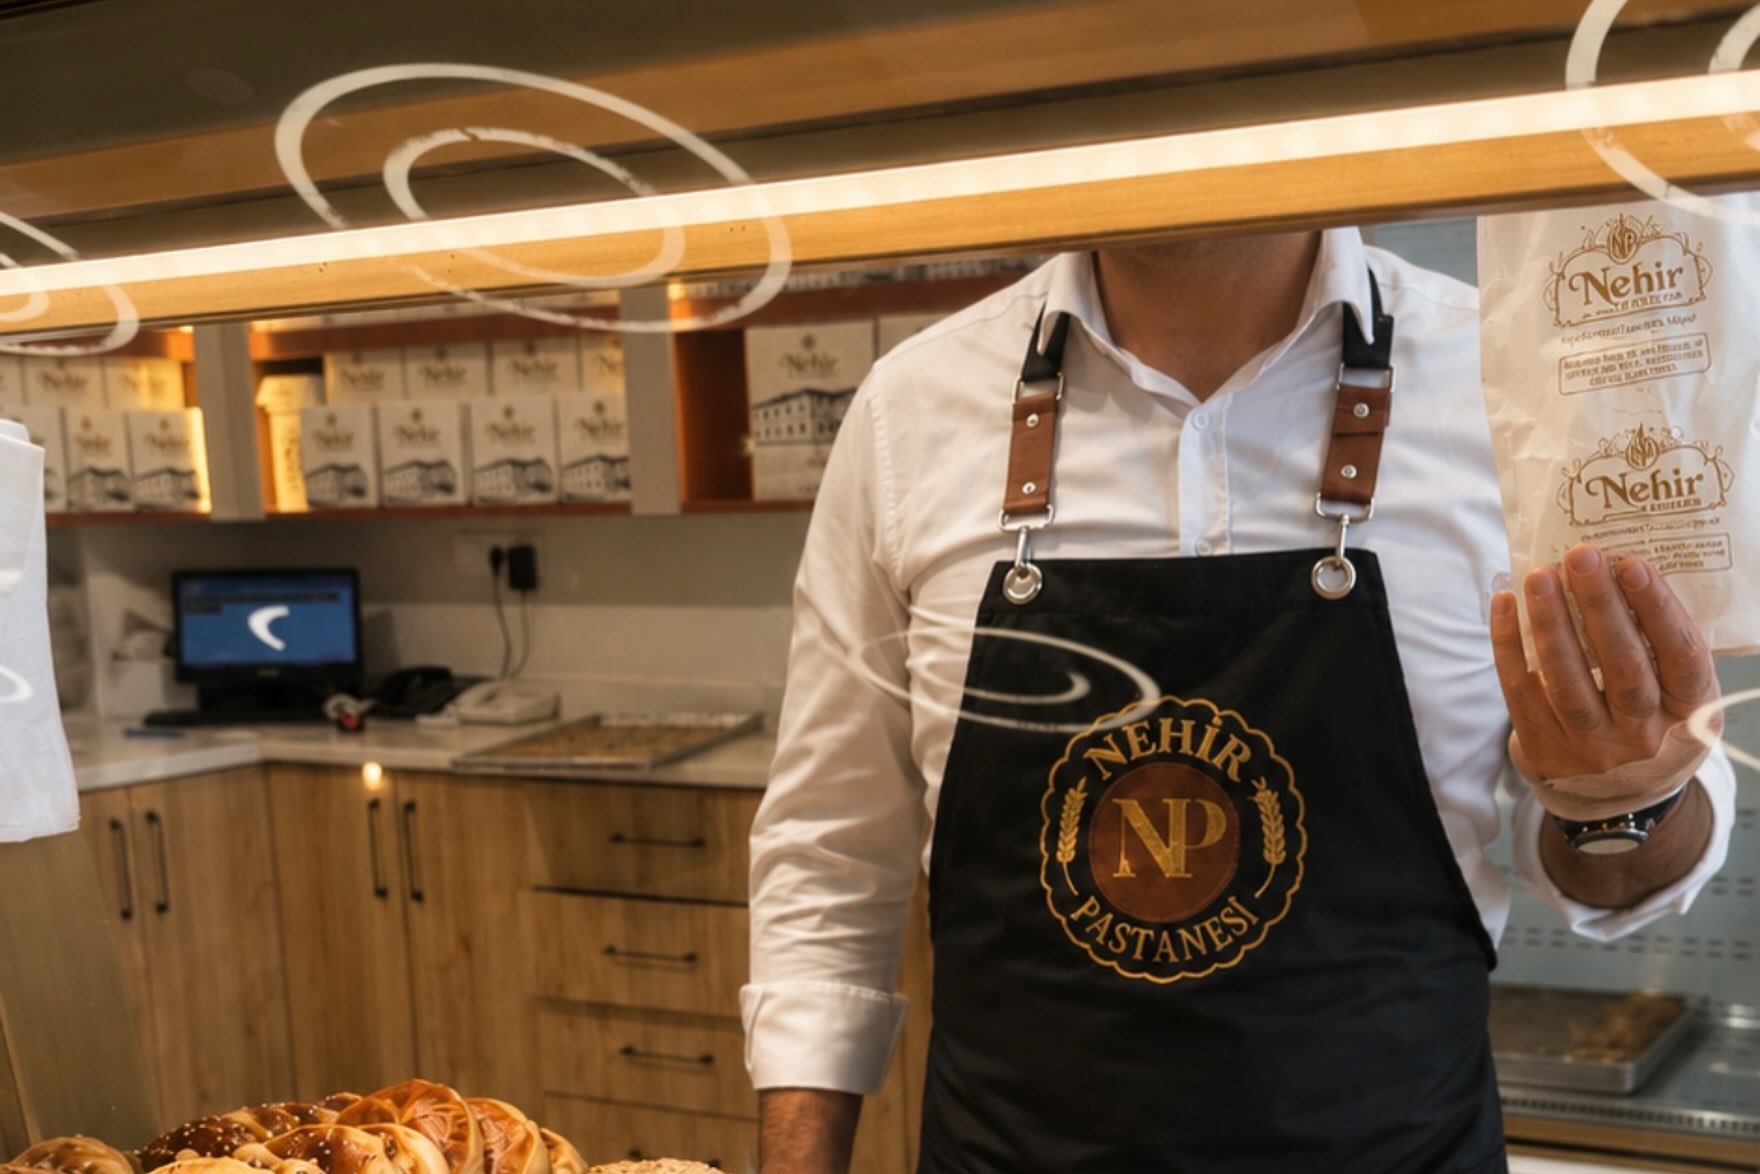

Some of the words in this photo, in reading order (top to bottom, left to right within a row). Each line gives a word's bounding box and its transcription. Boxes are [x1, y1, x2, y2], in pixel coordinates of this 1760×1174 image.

[1568, 261, 1684, 305] Nehir
[1585, 469, 1704, 509] Nehir
[1083, 716, 1252, 782] NEHİR
[1112, 798, 1227, 879] NP
